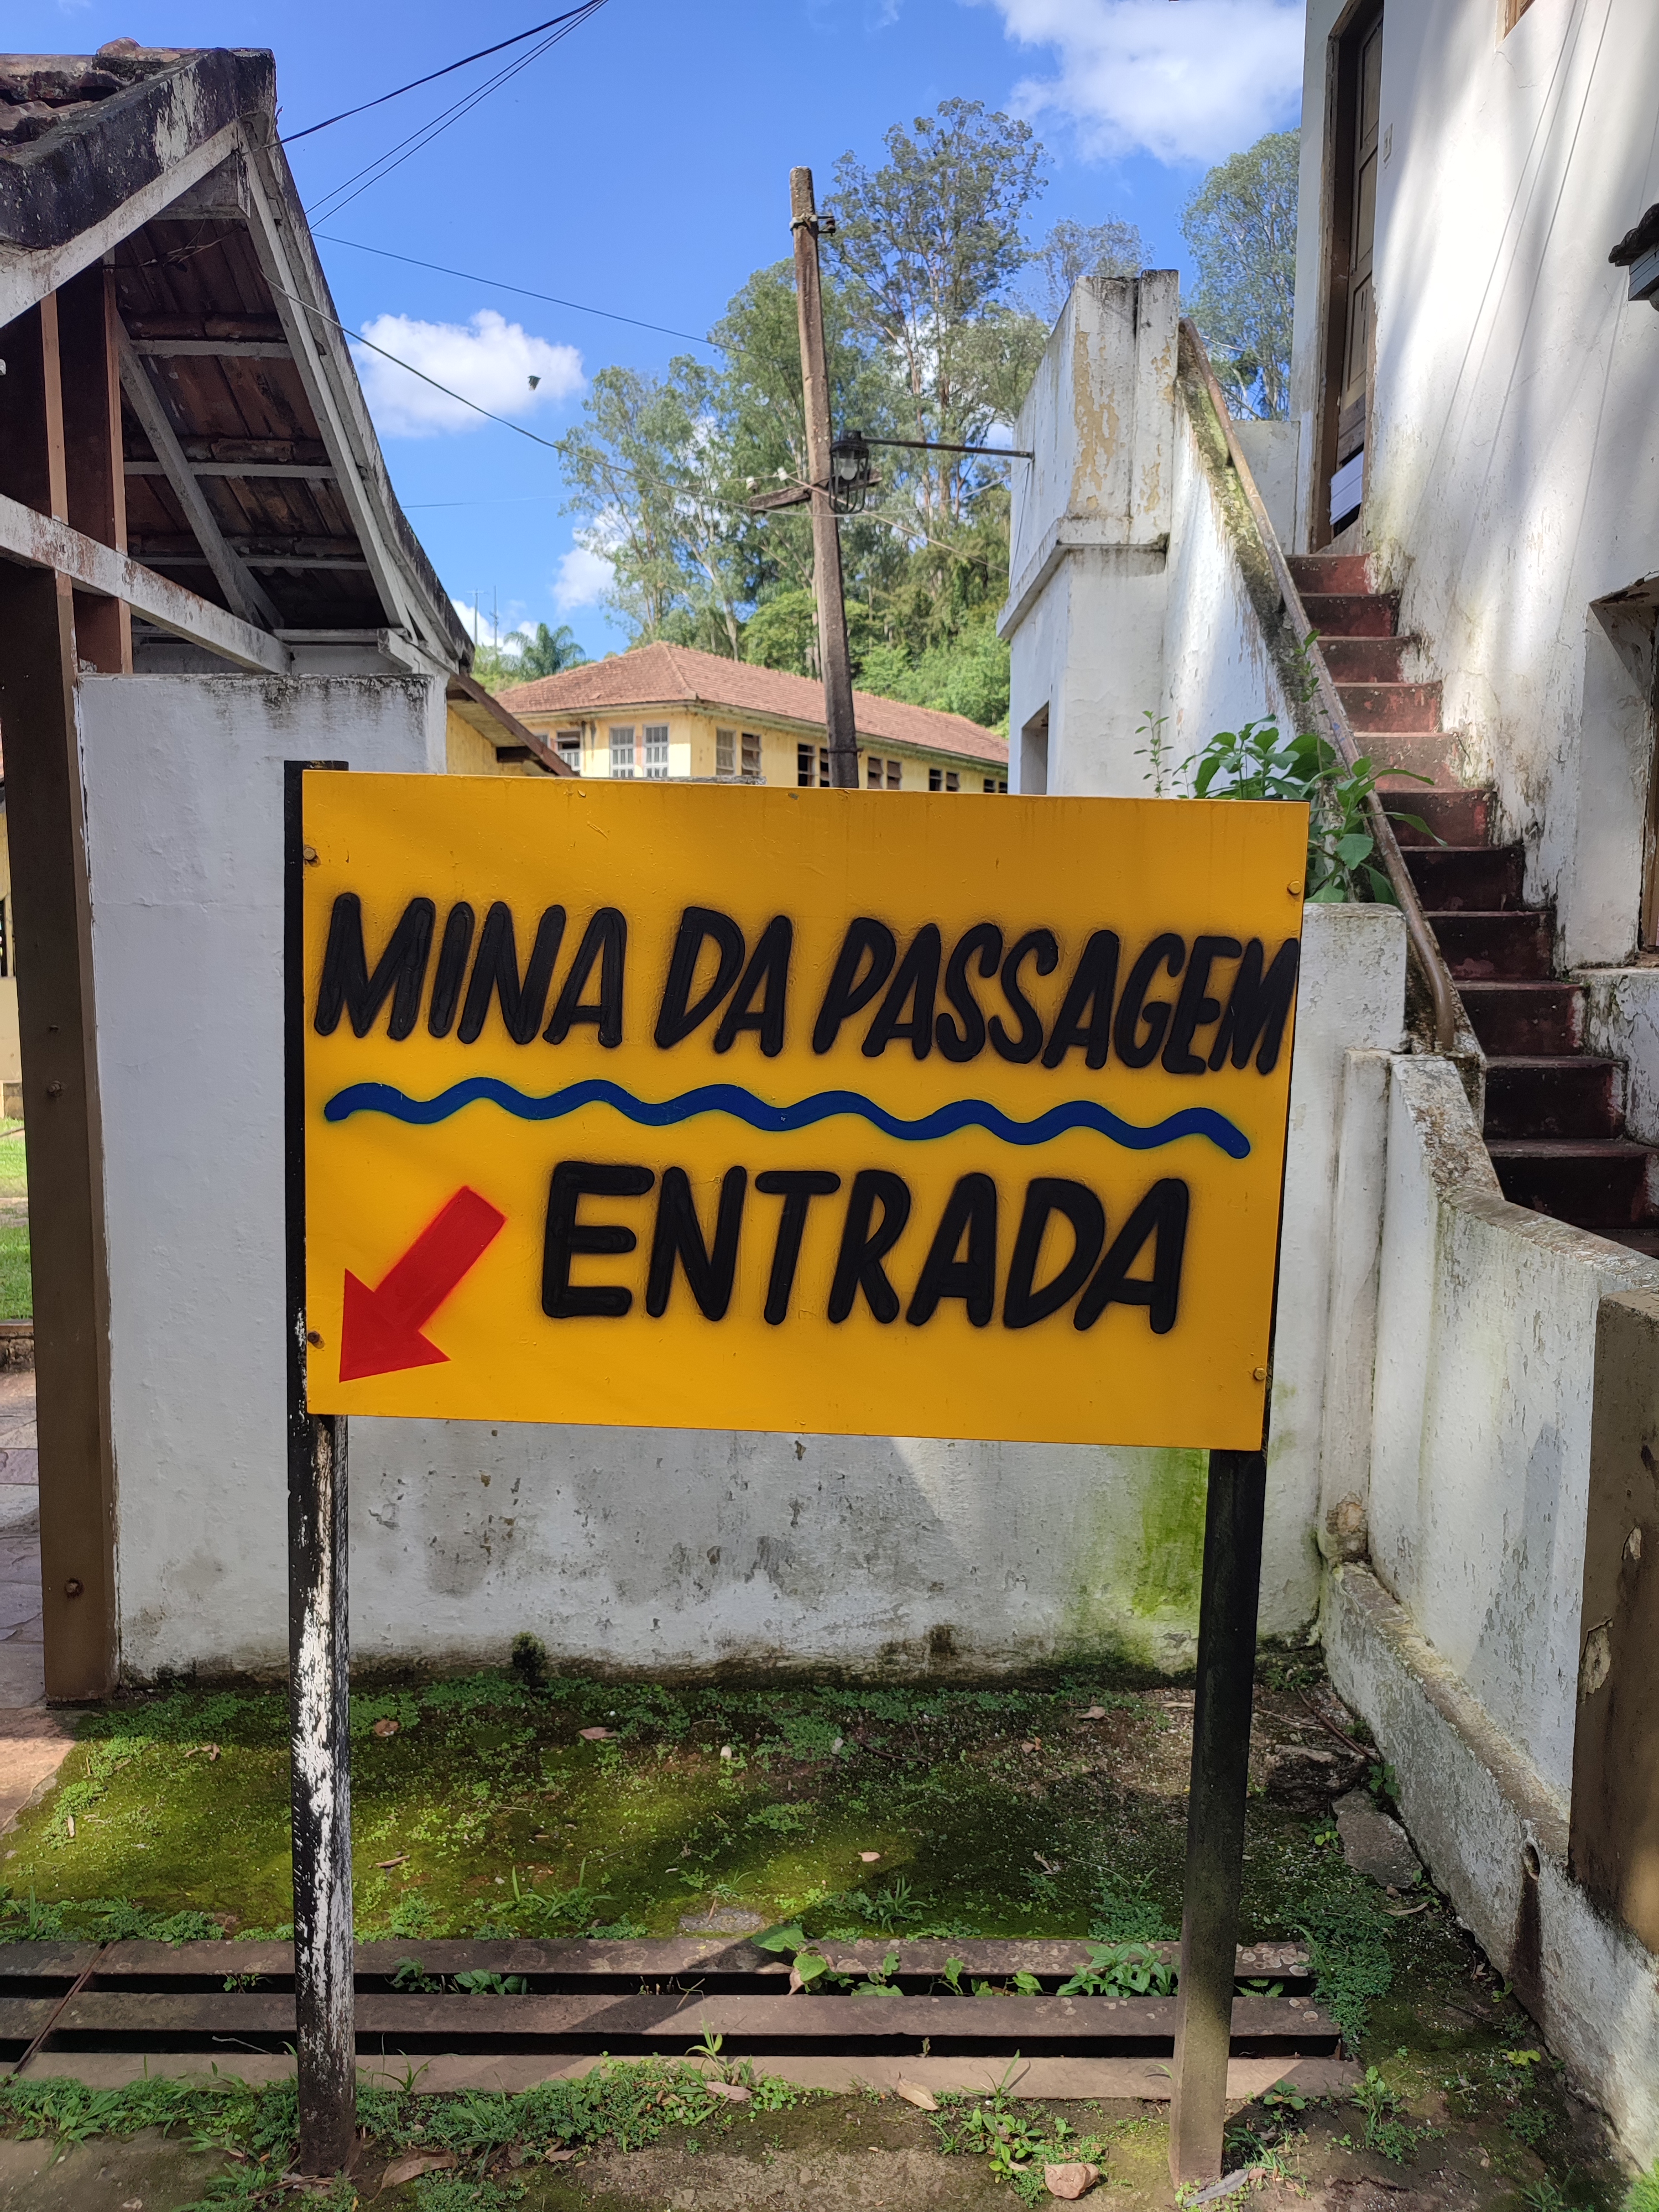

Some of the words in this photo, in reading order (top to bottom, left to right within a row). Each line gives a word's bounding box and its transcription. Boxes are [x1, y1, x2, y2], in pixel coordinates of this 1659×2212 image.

[314, 893, 627, 1048] MINA
[654, 906, 793, 1057] DA
[812, 917, 1298, 1075] PASSAGEM
[542, 1161, 1190, 1334] ENTRADA
